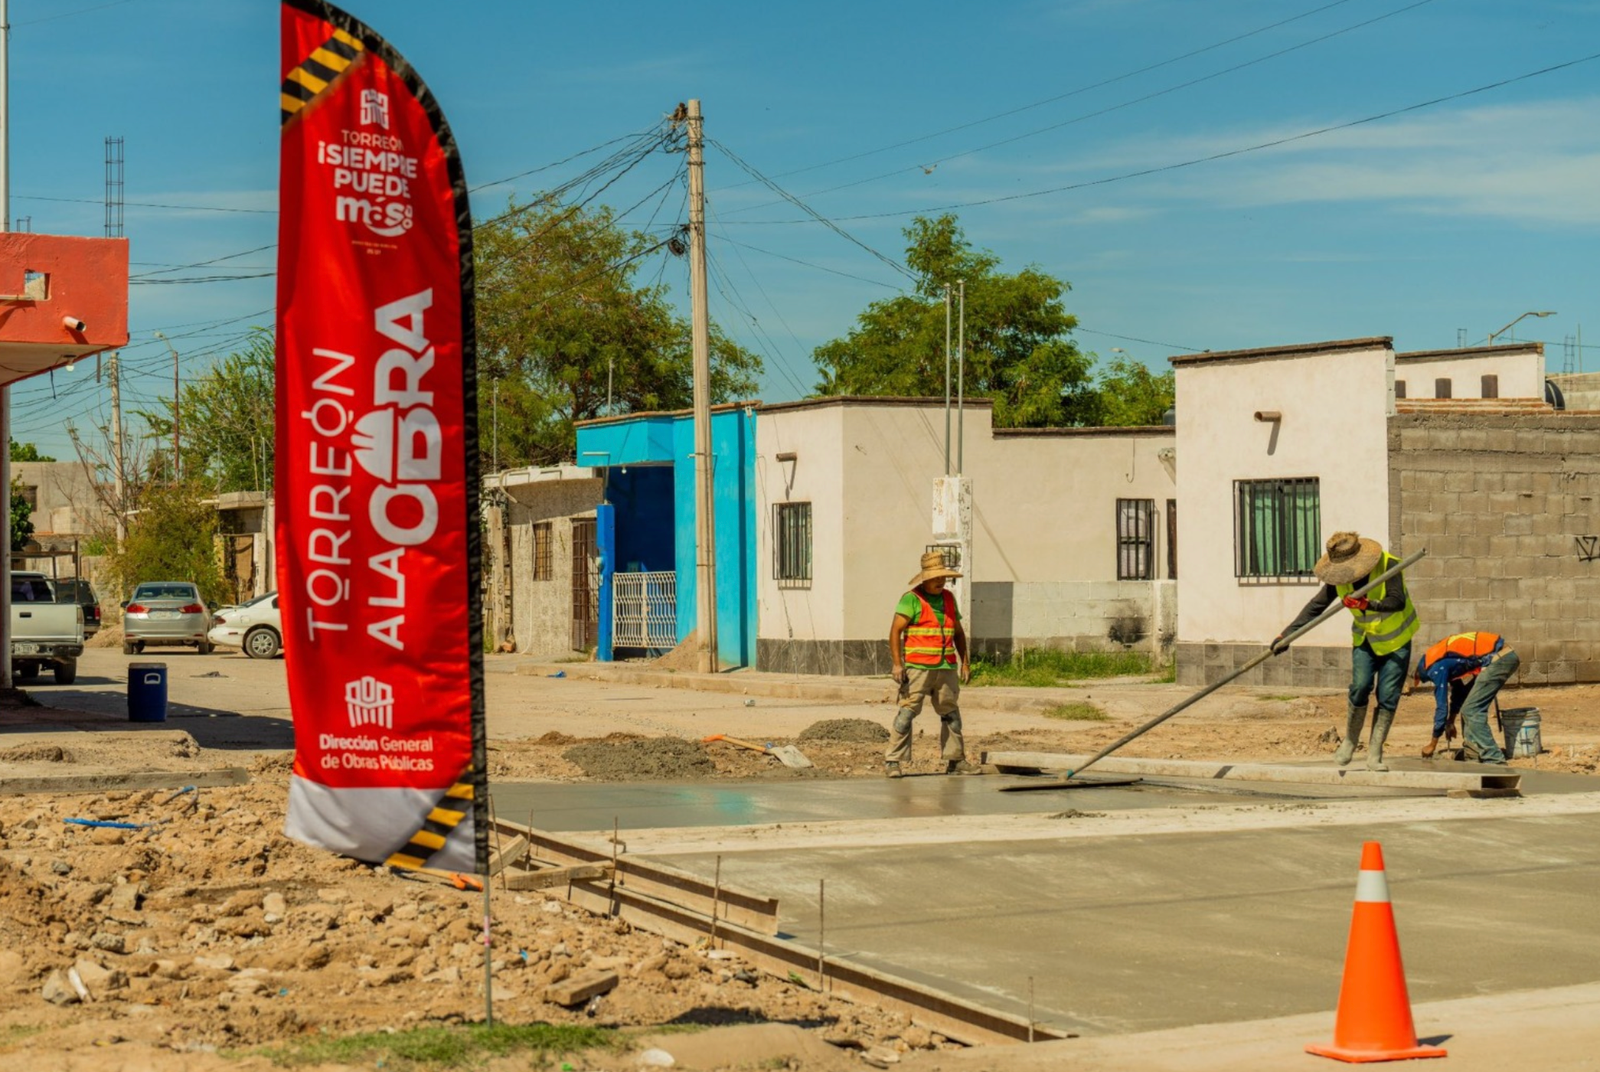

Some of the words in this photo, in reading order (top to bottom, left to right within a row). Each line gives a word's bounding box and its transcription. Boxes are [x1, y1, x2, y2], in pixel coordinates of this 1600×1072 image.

[334, 168, 411, 198] PUEDE
[301, 348, 355, 641] TORREÓN
[320, 734, 378, 751] Dirección
[380, 736, 433, 752] General
[321, 753, 339, 769] de
[342, 752, 379, 770] Obras
[380, 754, 434, 771] Públicas
